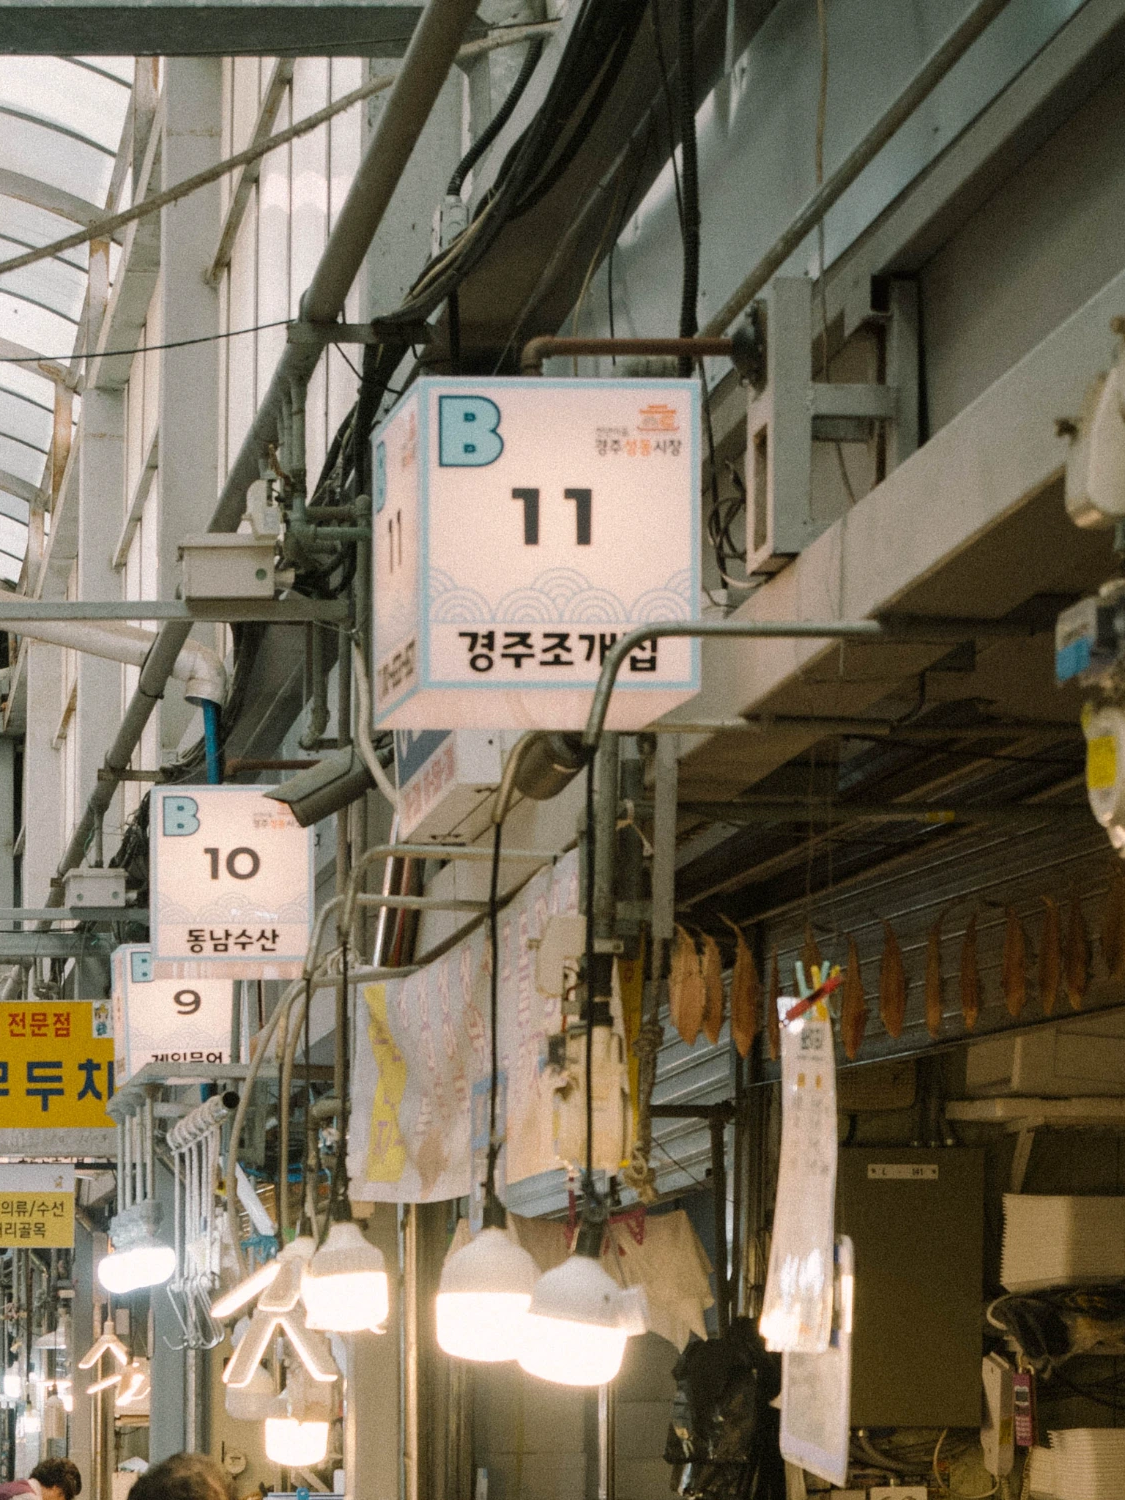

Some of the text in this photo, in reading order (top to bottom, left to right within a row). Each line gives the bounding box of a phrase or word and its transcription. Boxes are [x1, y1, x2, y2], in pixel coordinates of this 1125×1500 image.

[439, 395, 504, 467] B
[512, 488, 593, 546] 11
[457, 630, 658, 673] 경주조개집
[163, 796, 201, 837] B
[203, 847, 261, 880] 10
[186, 928, 280, 953] 동남수산
[131, 952, 155, 983] B
[173, 989, 202, 1016] 9
[7, 1012, 72, 1038] 전문점
[0, 1200, 65, 1218] 의류/수선
